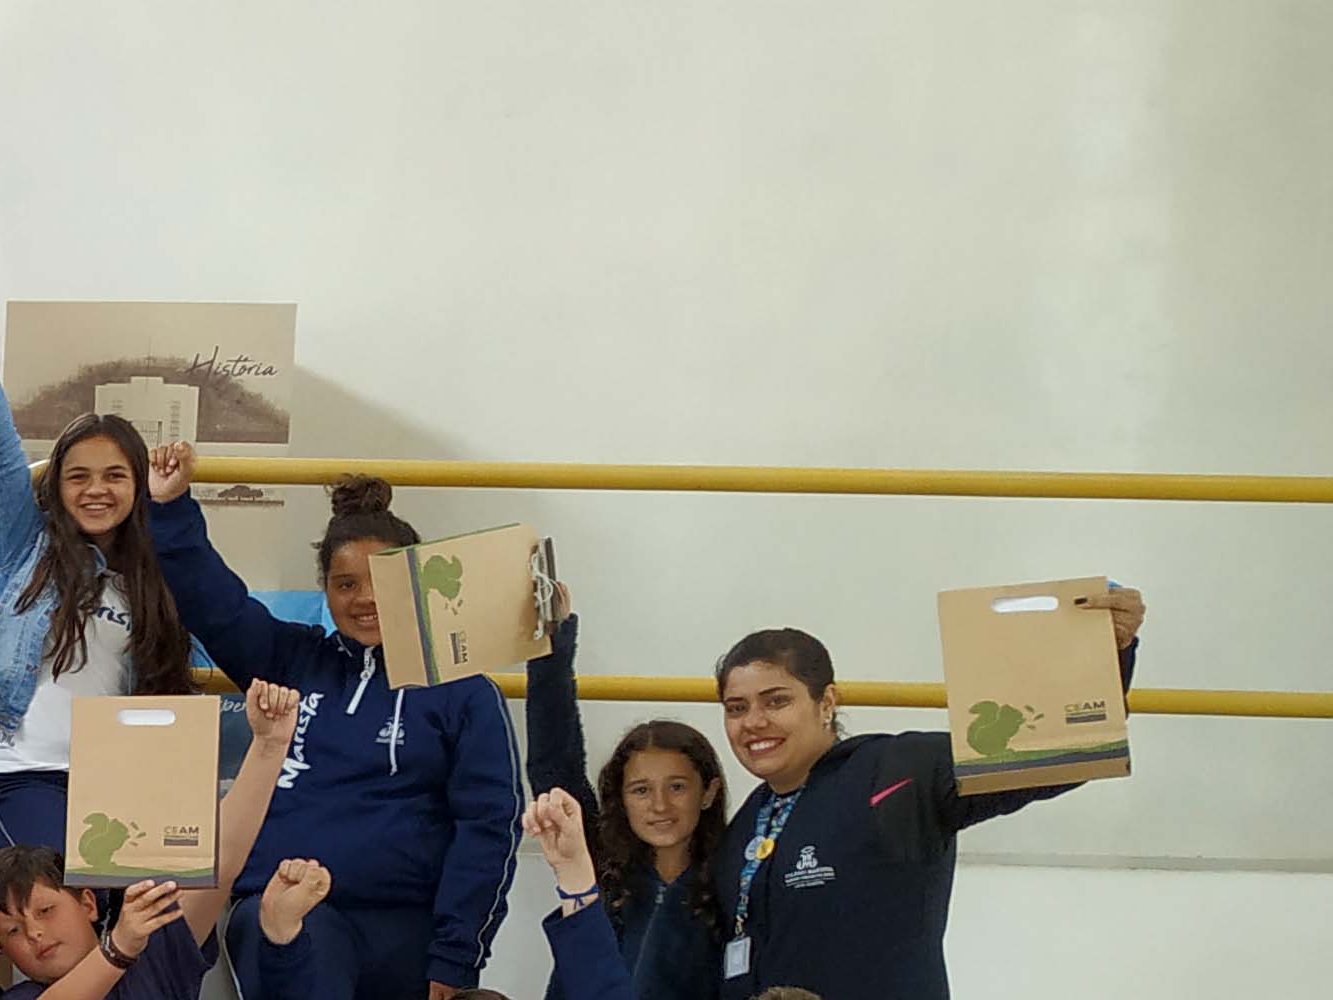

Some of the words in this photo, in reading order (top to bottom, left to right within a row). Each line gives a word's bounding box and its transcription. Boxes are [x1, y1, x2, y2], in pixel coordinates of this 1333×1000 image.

[186, 345, 278, 378] História
[1064, 700, 1106, 713] CEAM
[164, 826, 199, 836] CEAM
